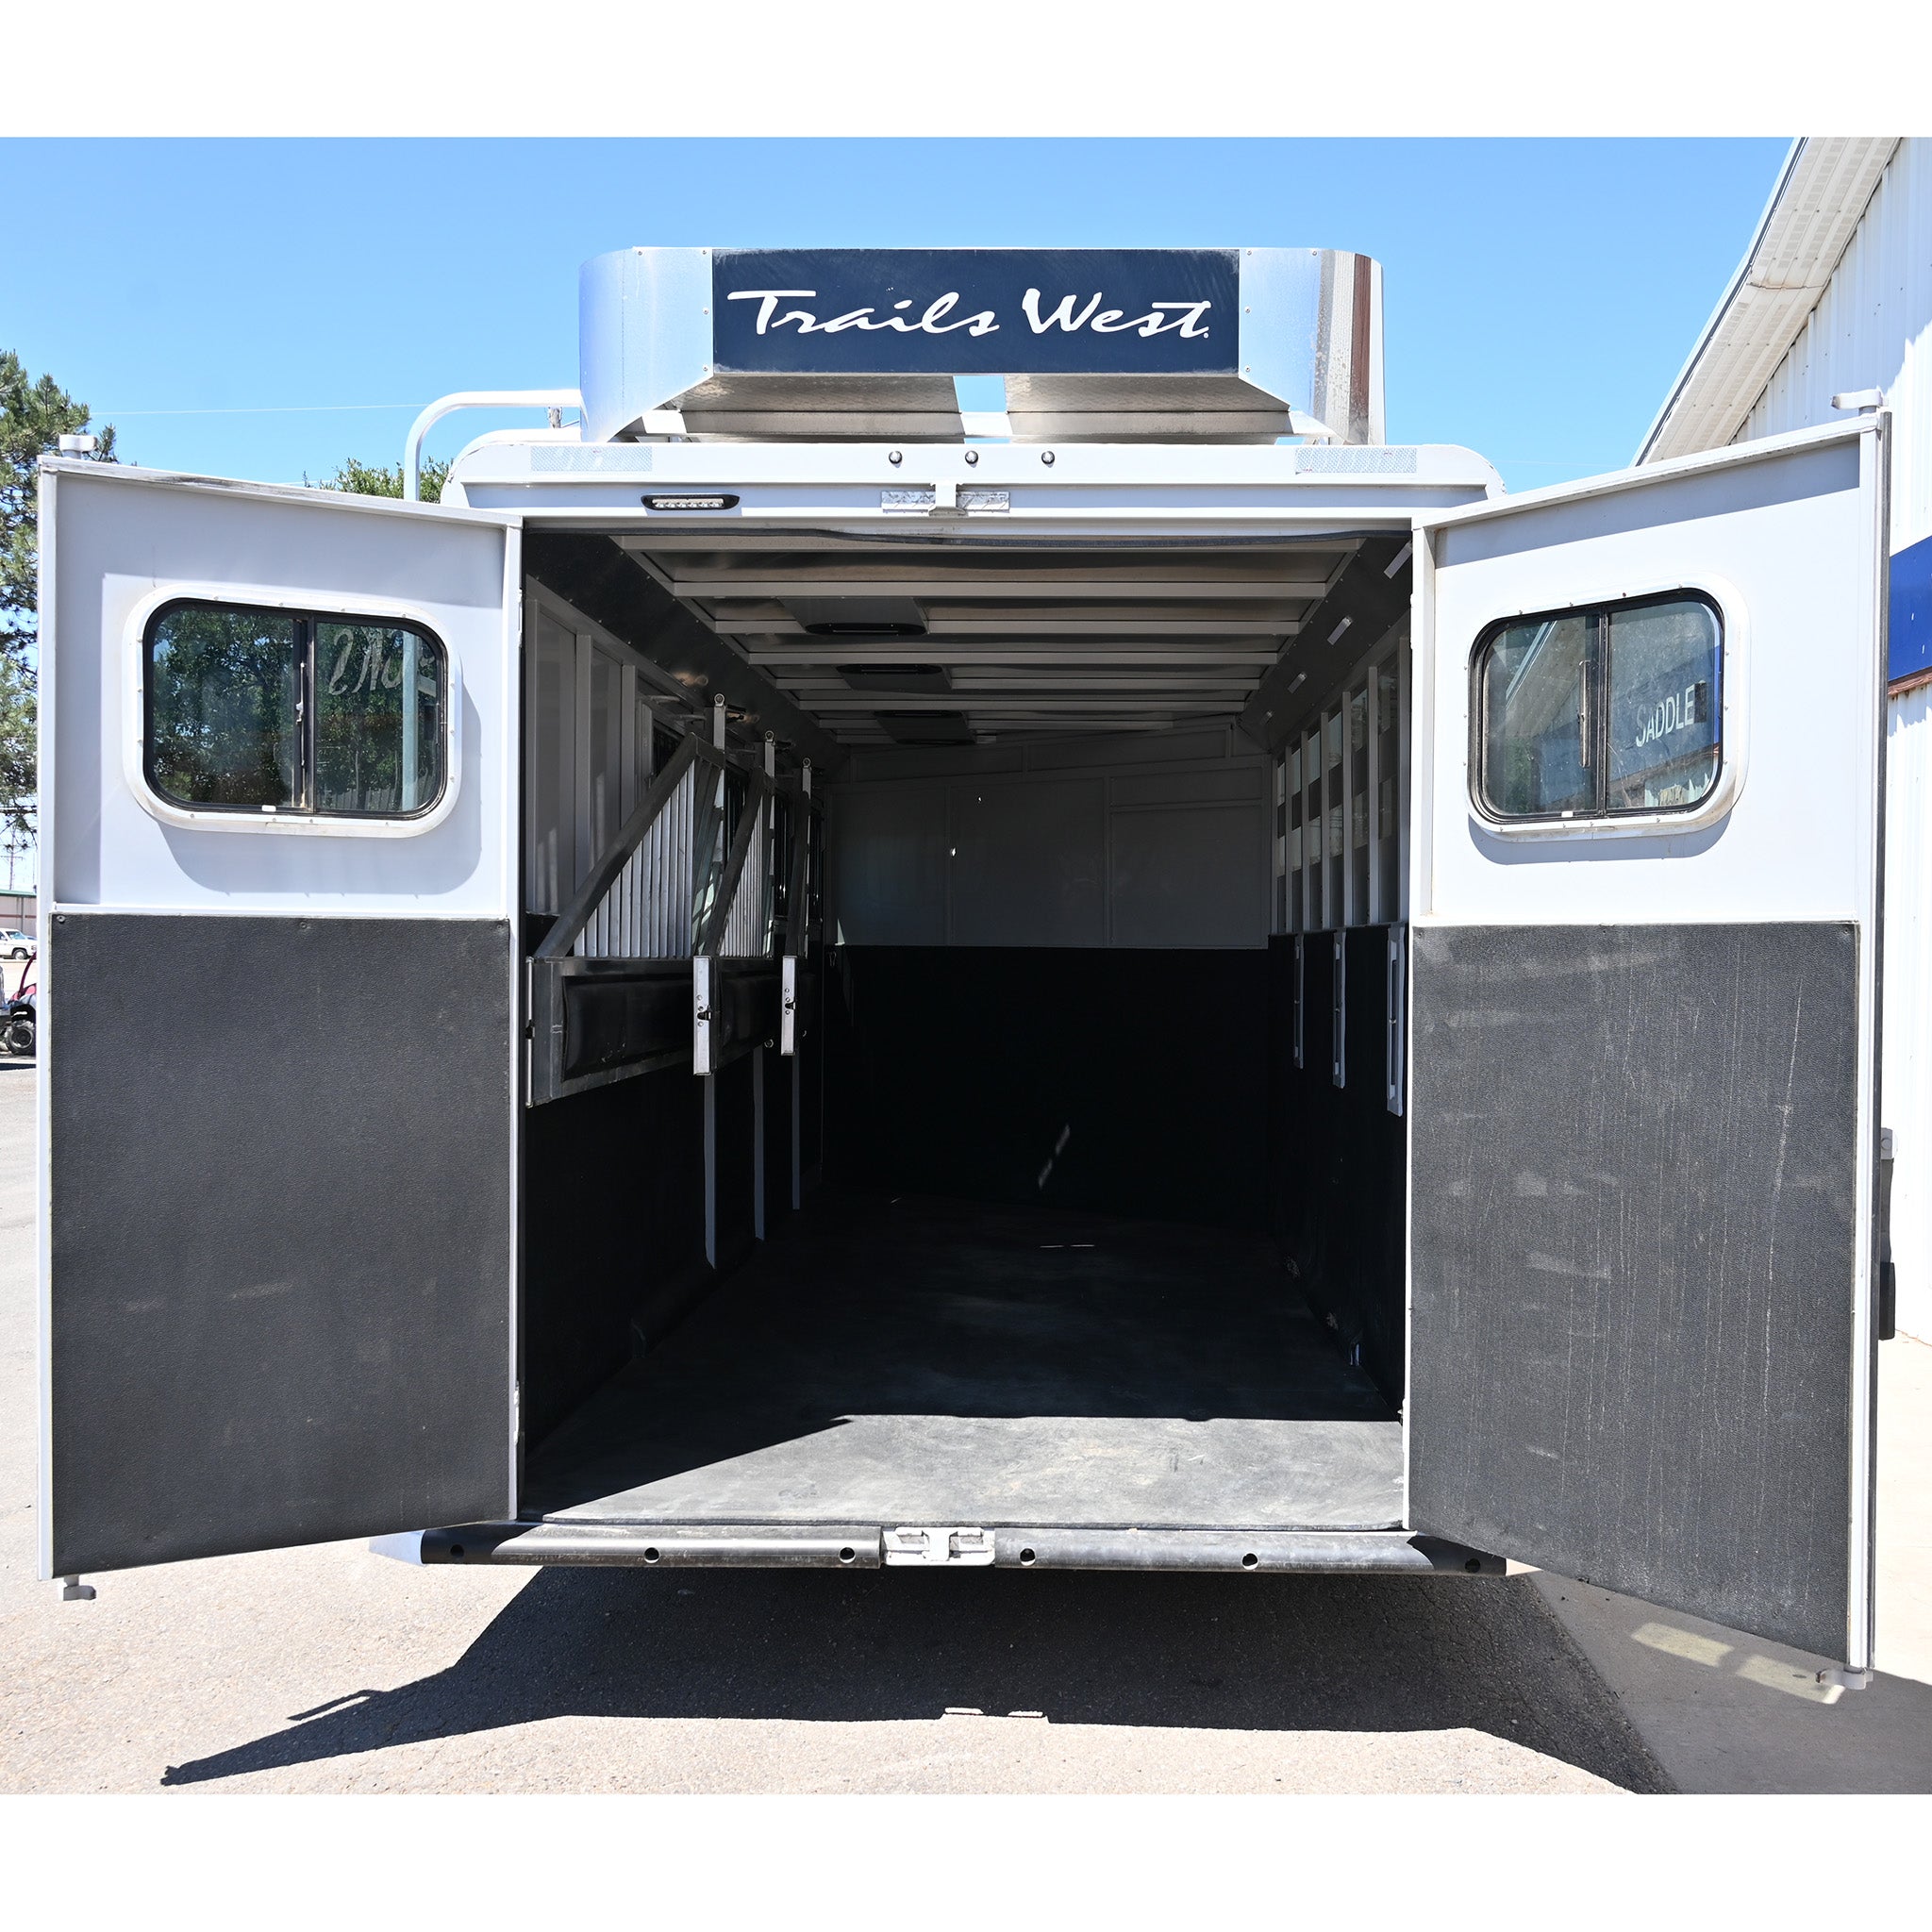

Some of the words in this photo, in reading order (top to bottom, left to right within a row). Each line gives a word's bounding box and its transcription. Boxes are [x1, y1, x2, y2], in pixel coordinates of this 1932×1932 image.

[726, 290, 1000, 337] Trails
[1022, 288, 1211, 339] West
[1636, 680, 1707, 747] SADDLE
